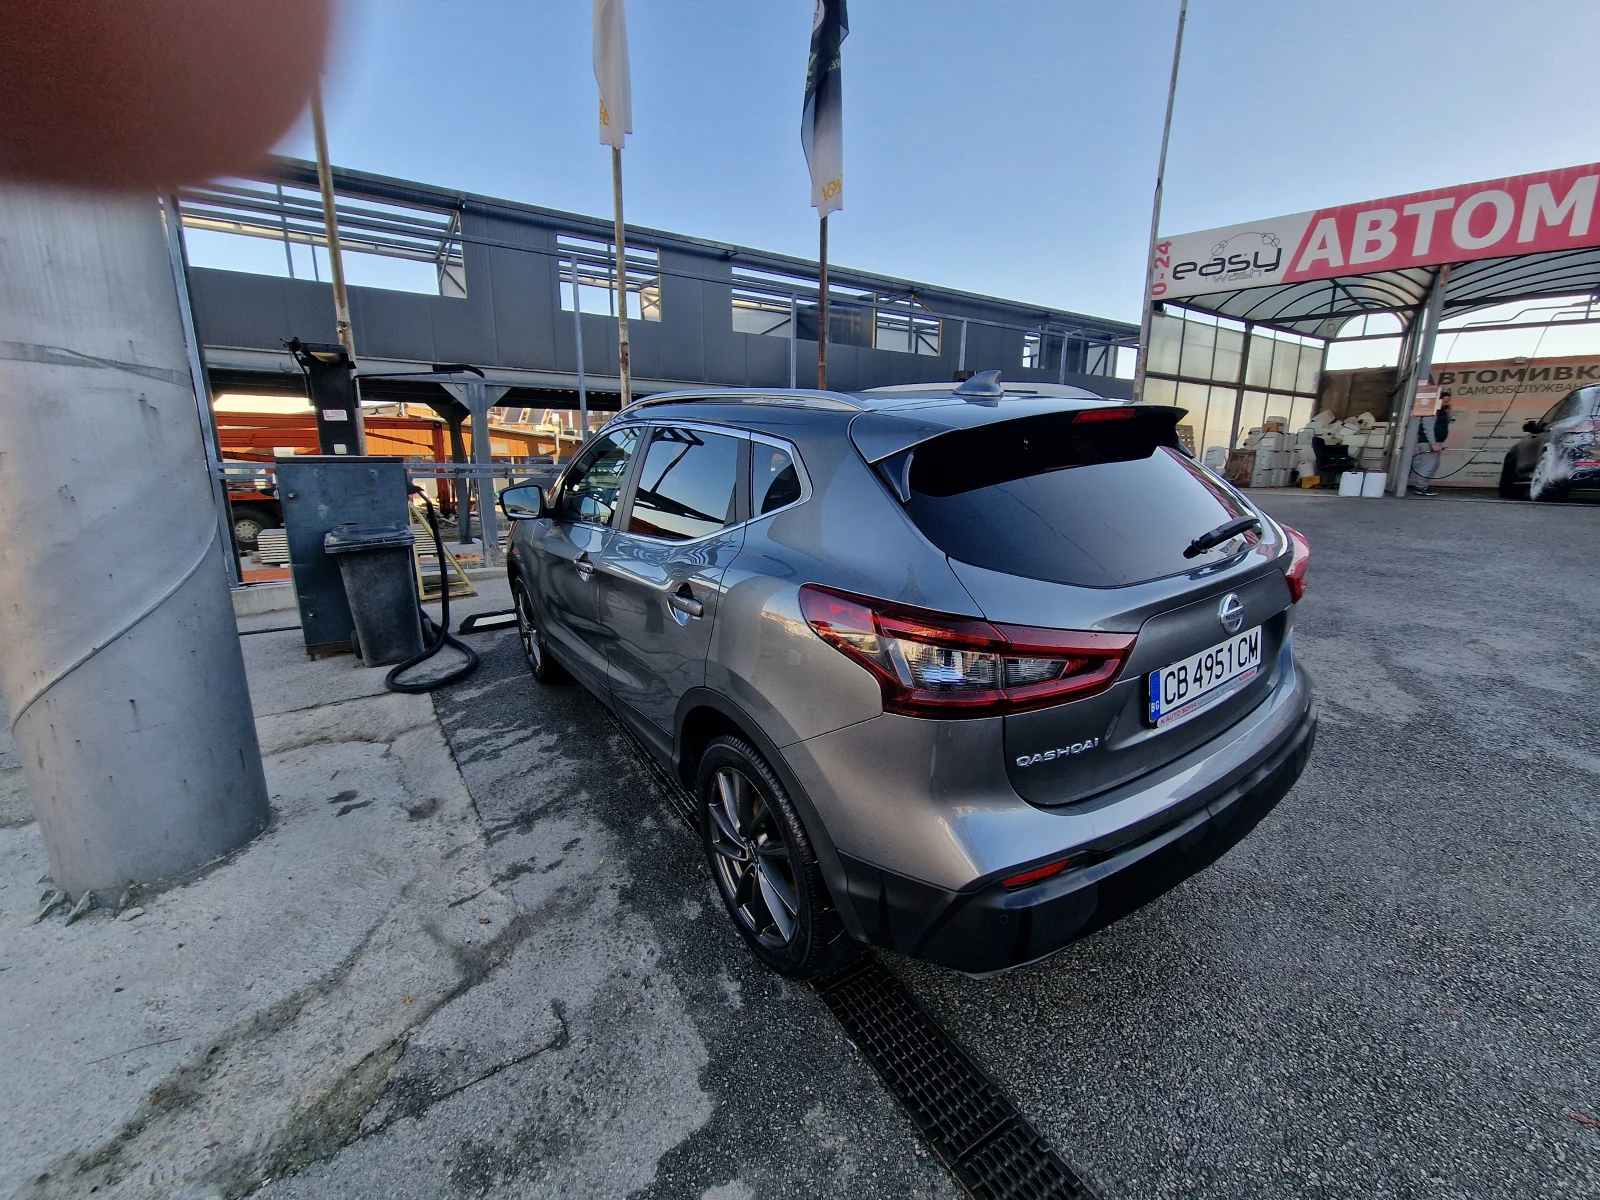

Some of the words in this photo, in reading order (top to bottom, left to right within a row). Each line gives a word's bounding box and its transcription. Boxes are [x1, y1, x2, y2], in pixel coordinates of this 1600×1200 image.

[1295, 174, 1600, 273] АВТОМ
[1151, 240, 1173, 297] 0-24
[1172, 247, 1282, 281] easy
[1212, 267, 1263, 284] wash
[1428, 366, 1600, 386] ВТОМИВК
[1457, 383, 1592, 395] САМООБСЛУЖВАН
[1164, 665, 1189, 706] CB
[1193, 642, 1233, 689] 4951
[1237, 631, 1258, 668] CM
[1150, 700, 1160, 714] BG
[1016, 736, 1099, 768] QASHQAI
